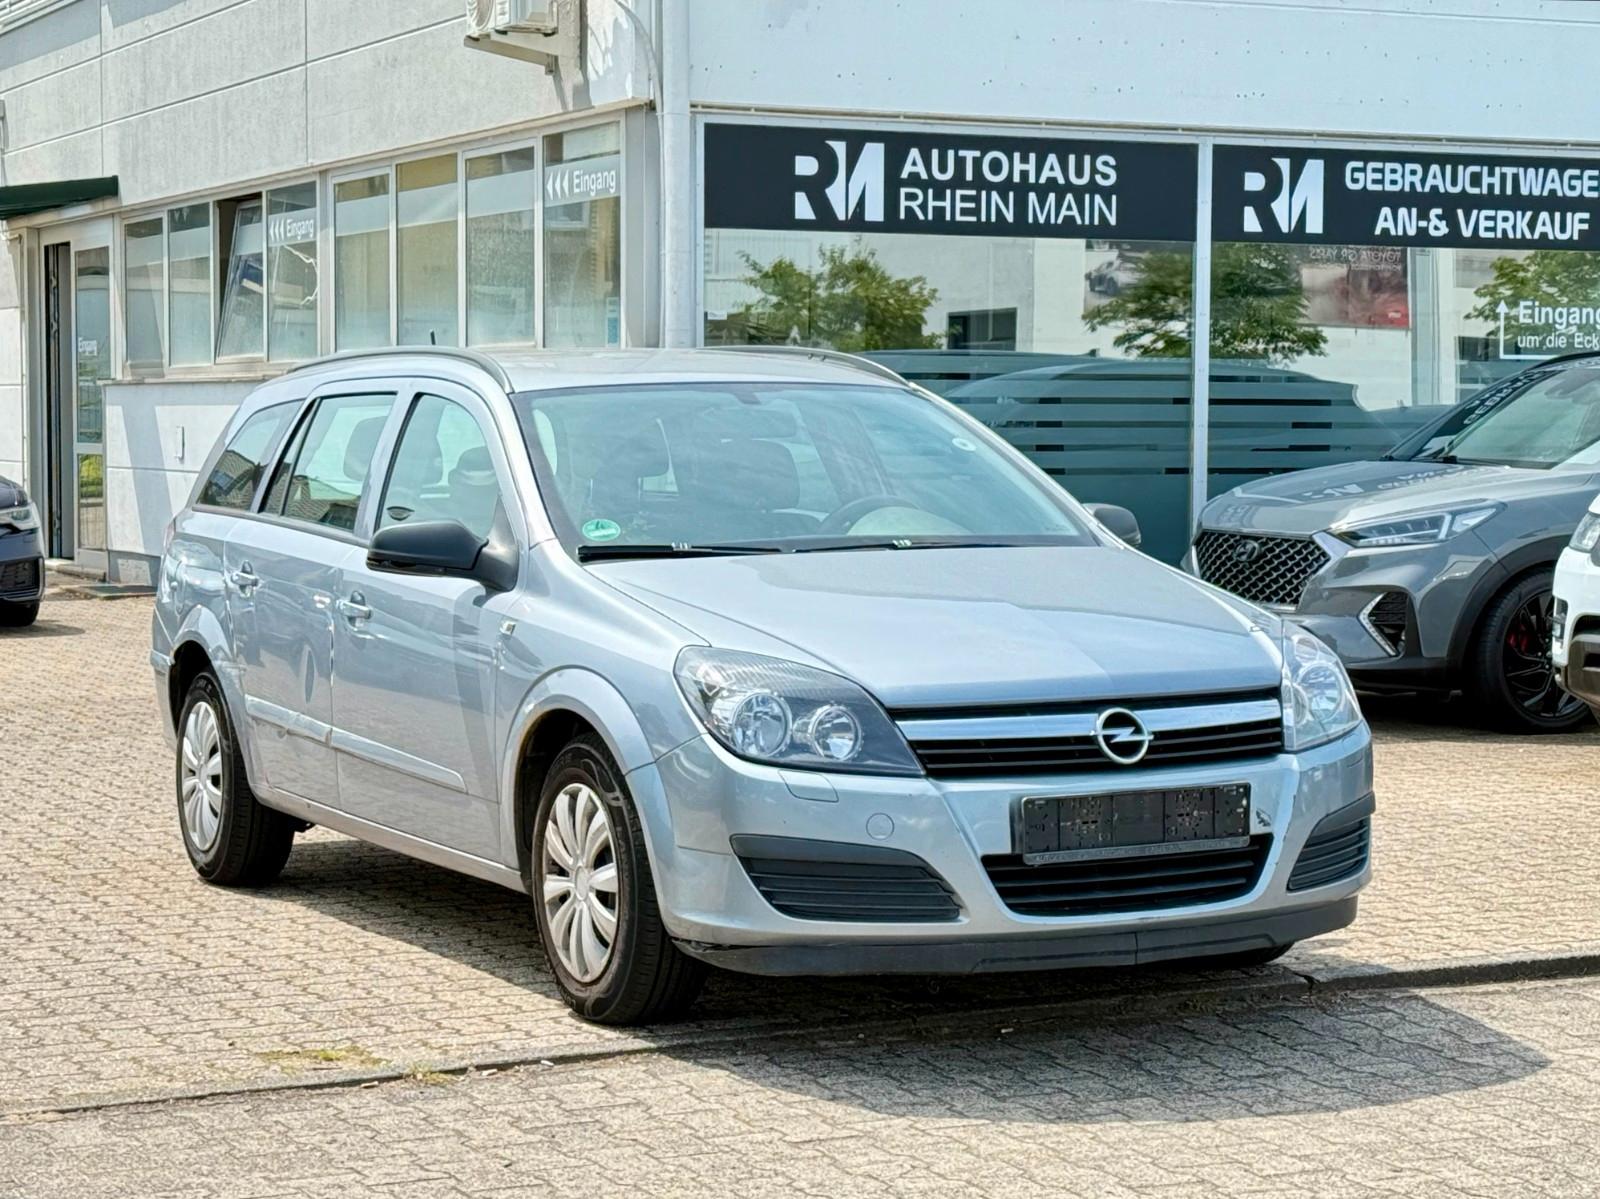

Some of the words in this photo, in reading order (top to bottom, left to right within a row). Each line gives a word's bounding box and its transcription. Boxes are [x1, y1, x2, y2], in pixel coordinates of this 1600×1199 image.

[573, 169, 616, 197] Eingang
[900, 147, 1117, 186] AUTOHAUS
[1345, 161, 1600, 198] GEBRAUCHTWAGE
[900, 187, 1014, 223] RHEIN
[1027, 192, 1117, 226] MAIN
[1374, 206, 1450, 237] AN-&
[1457, 208, 1591, 240] VERKAUF
[286, 218, 314, 241] Eingang
[1517, 334, 1540, 348] um
[1546, 332, 1567, 349] die
